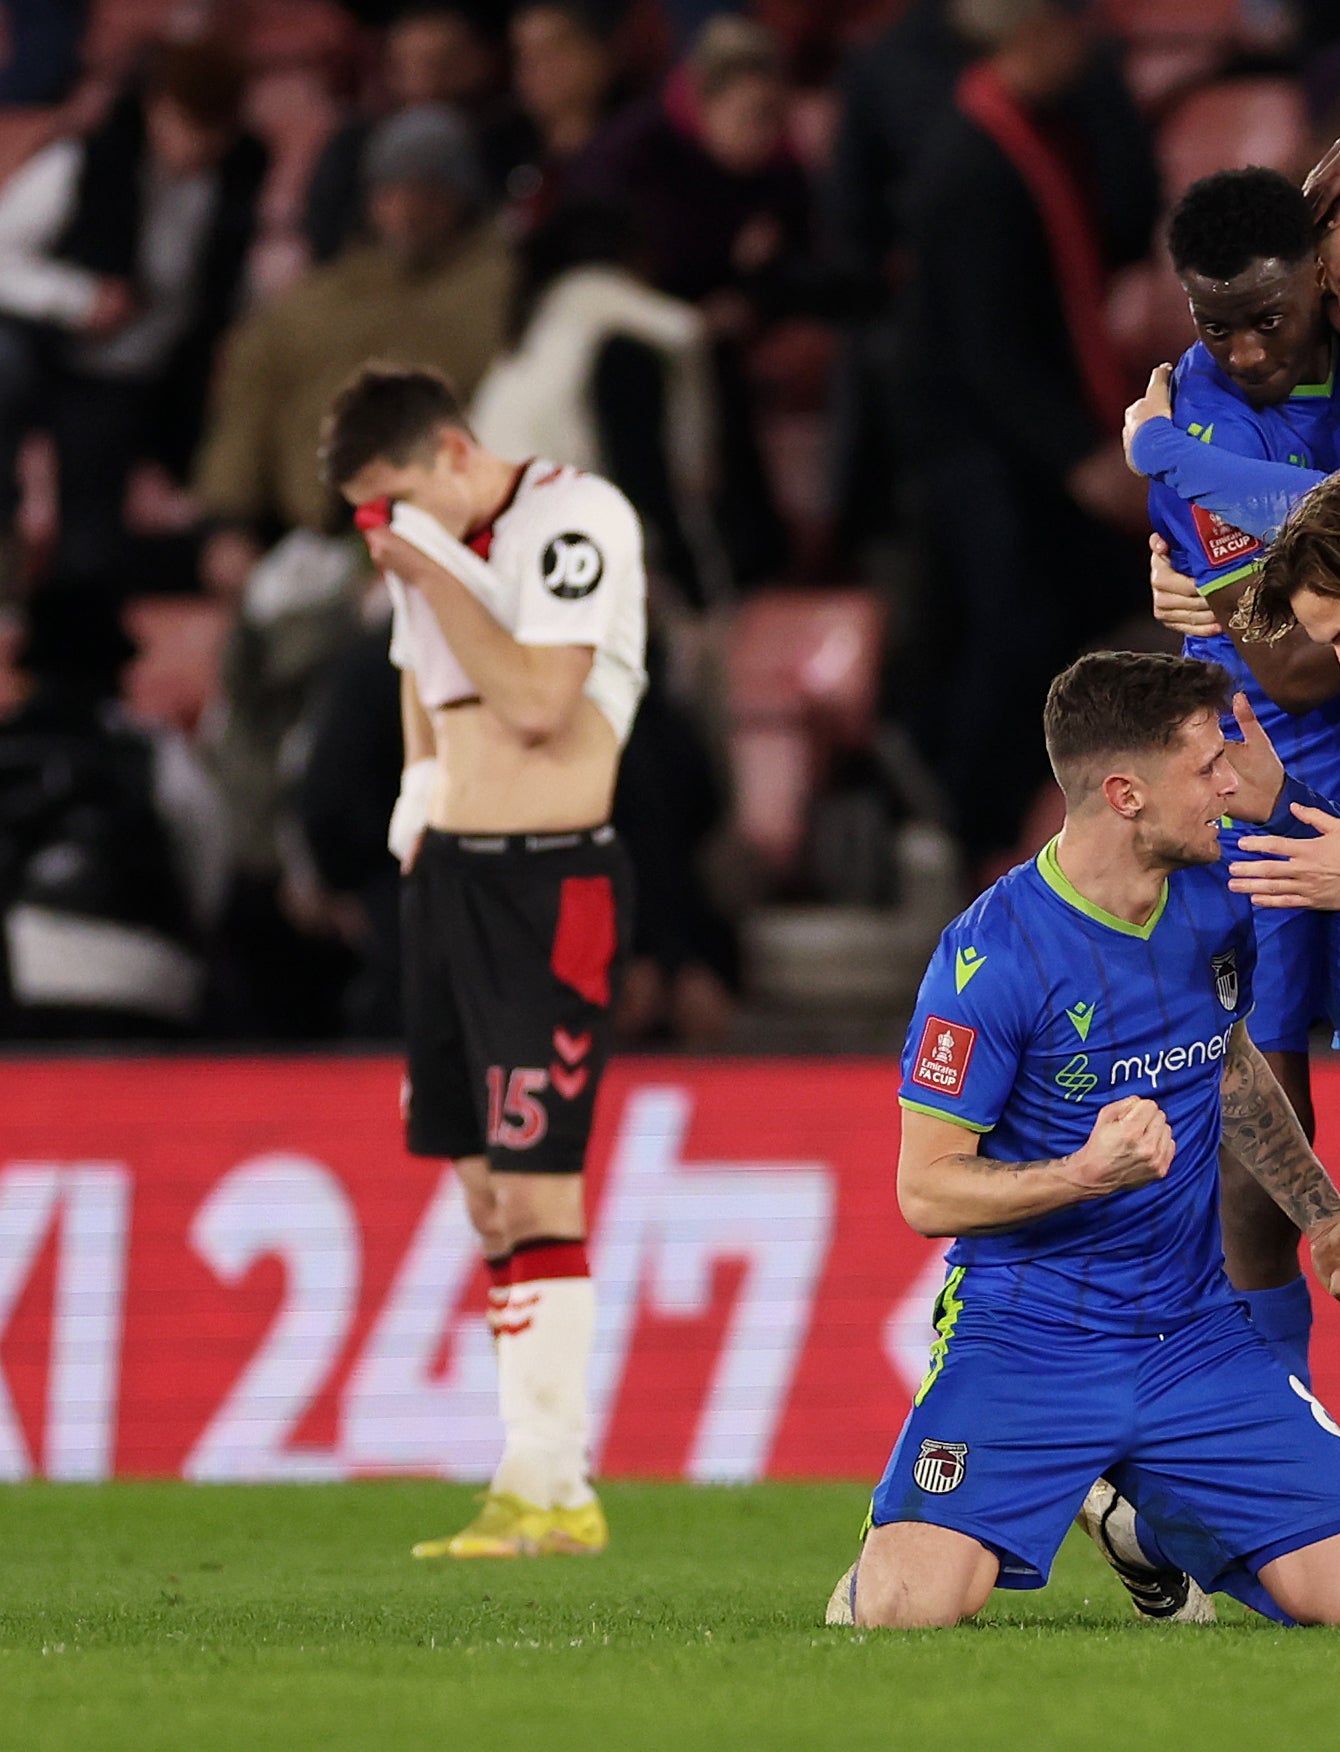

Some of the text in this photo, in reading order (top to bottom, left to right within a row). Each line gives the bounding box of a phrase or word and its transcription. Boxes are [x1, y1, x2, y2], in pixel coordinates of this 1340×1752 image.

[544, 540, 600, 588] JD
[1212, 535, 1250, 558] FA CUP
[919, 1067, 956, 1086] FA CUP
[922, 1058, 957, 1077] Emirates
[486, 1066, 549, 1150] 15
[183, 1085, 837, 1483] 24/7
